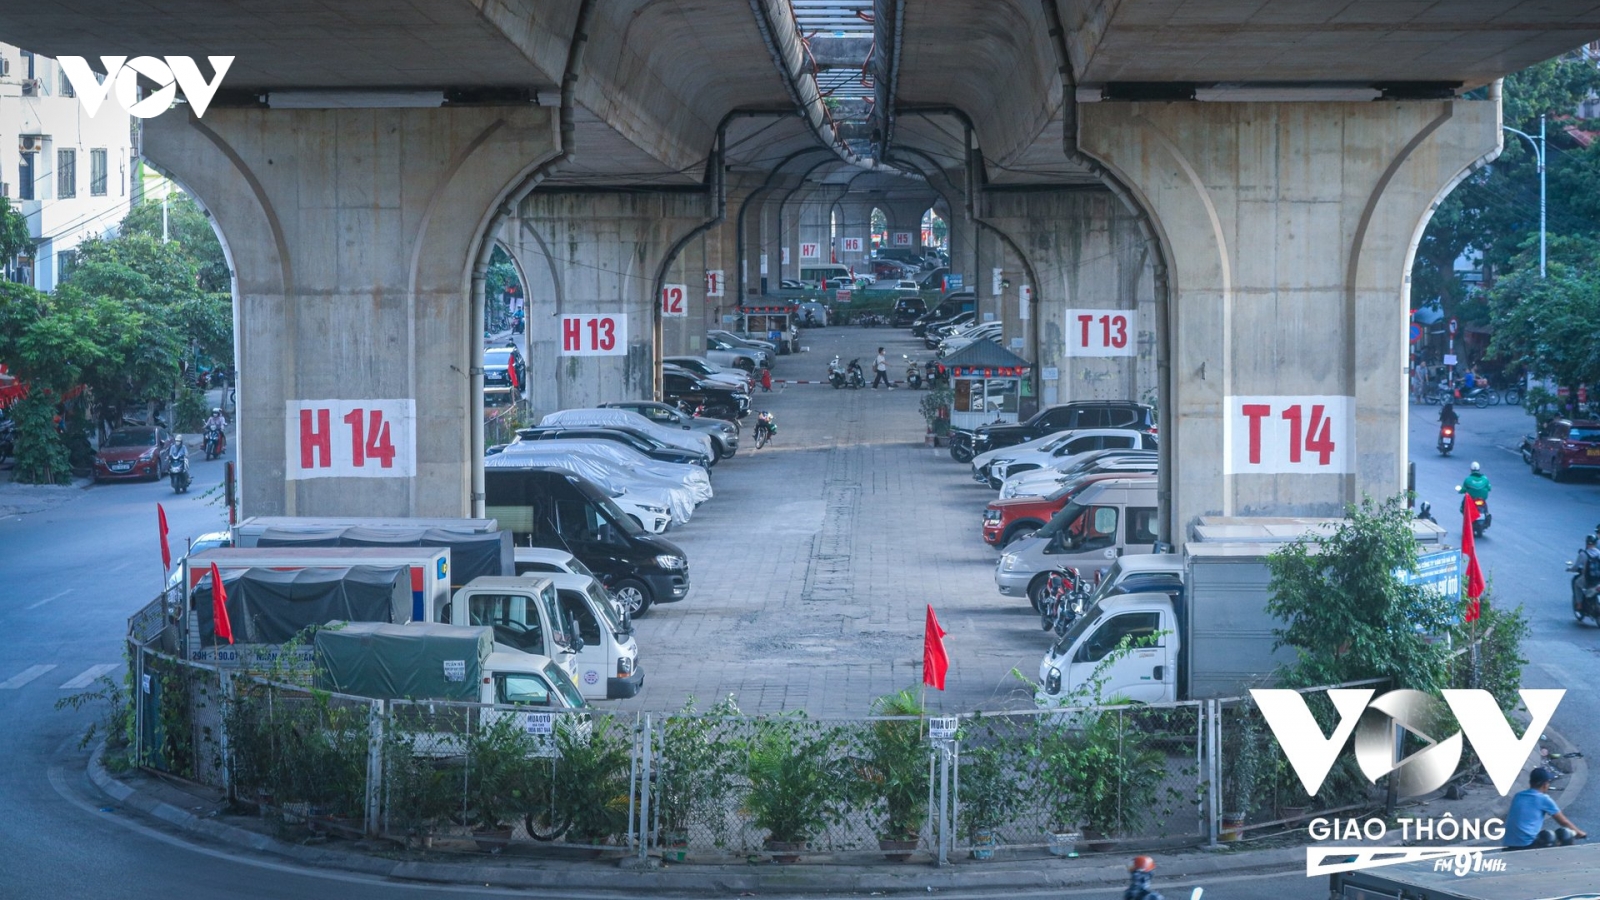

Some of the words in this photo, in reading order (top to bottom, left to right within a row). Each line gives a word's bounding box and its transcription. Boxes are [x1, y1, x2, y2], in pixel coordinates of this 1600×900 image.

[803, 244, 816, 257] H7
[845, 239, 858, 250] H6
[897, 233, 908, 244] H5
[662, 288, 683, 313] 12
[564, 318, 581, 351] H
[587, 317, 616, 351] 13
[1078, 314, 1093, 347] T
[1099, 314, 1128, 349] 13
[299, 408, 331, 469] H
[343, 408, 396, 468] 14
[1242, 404, 1271, 464] T
[1281, 404, 1336, 466] 14
